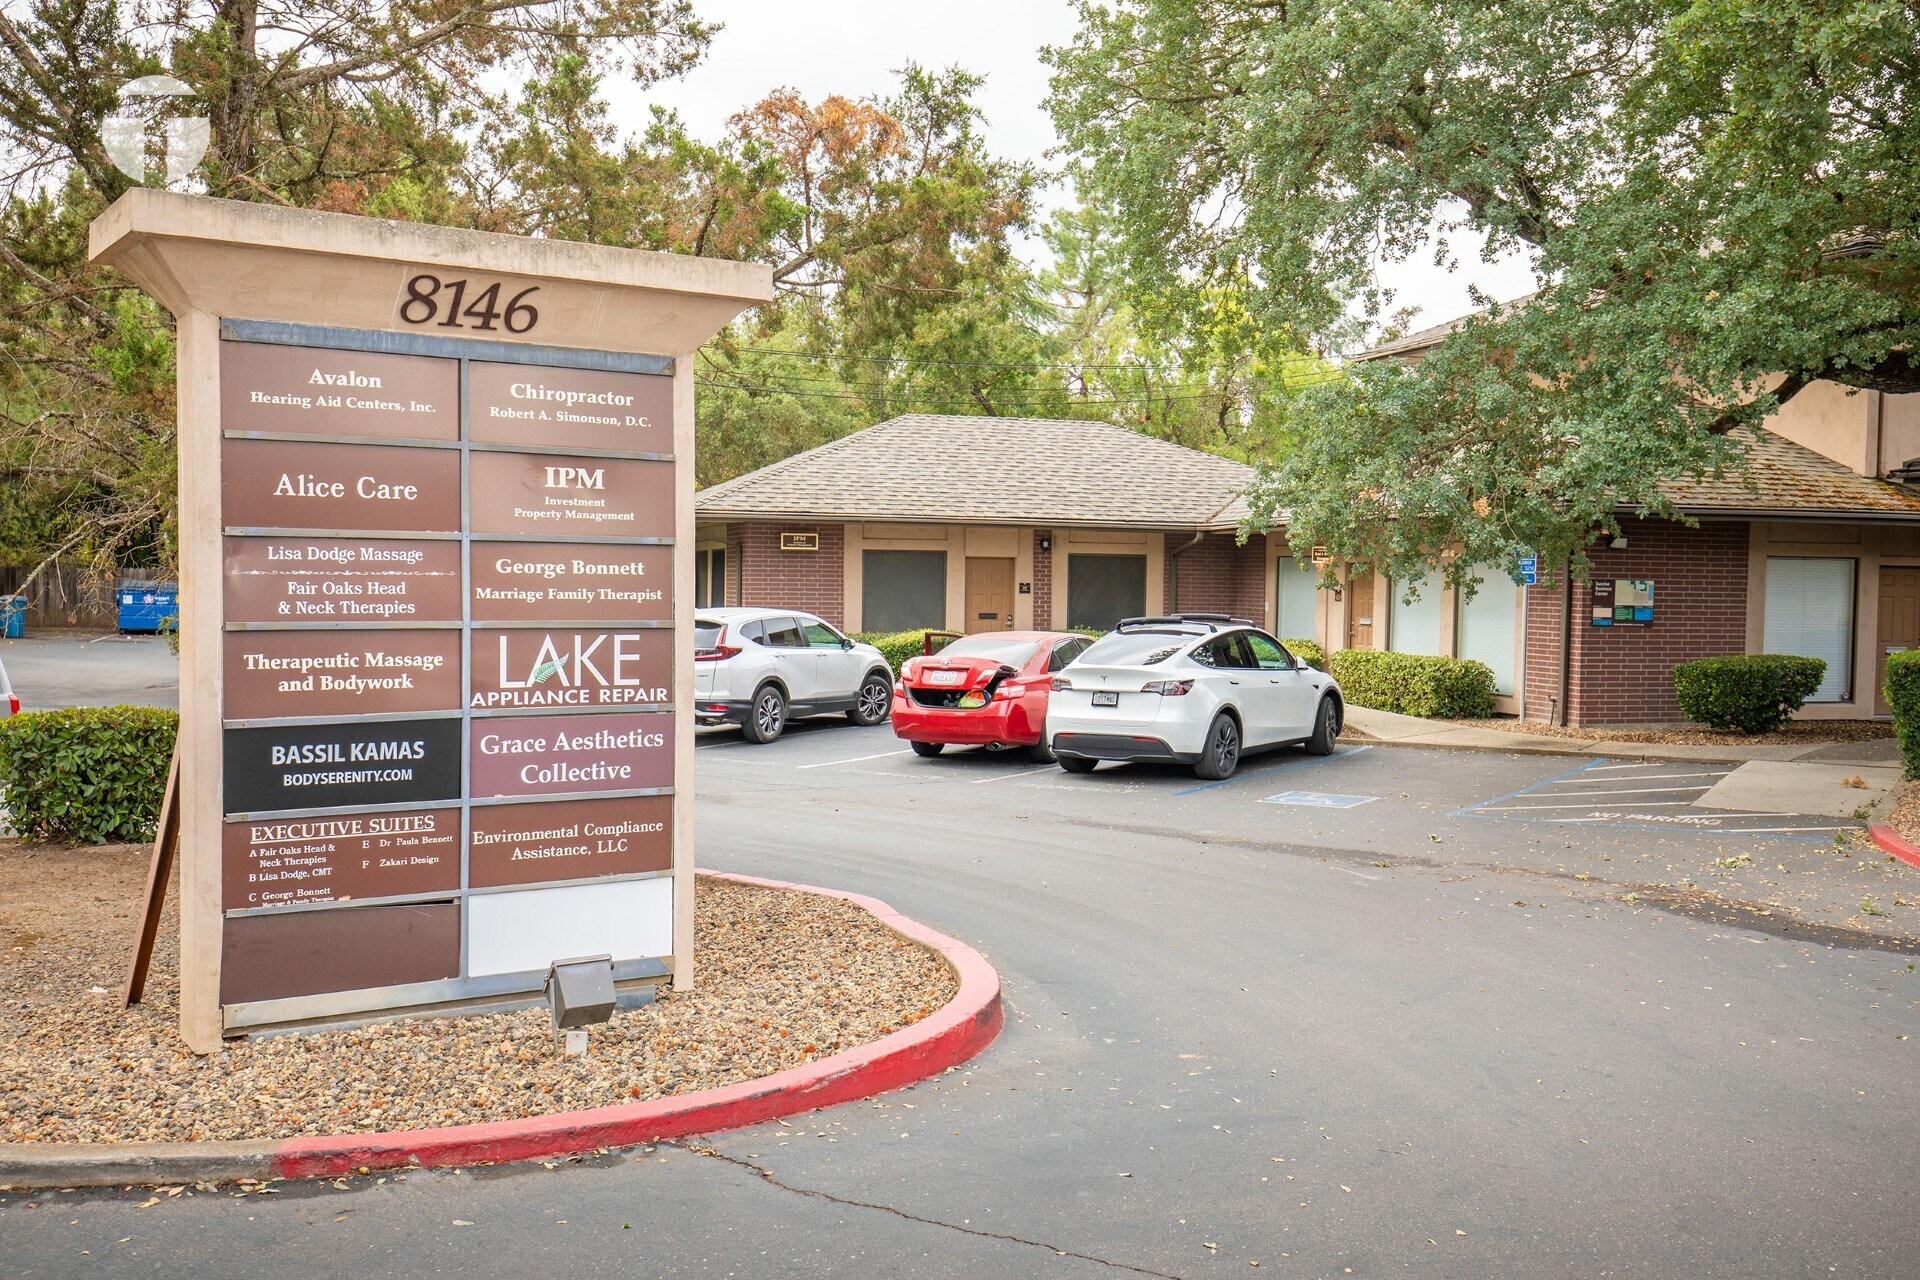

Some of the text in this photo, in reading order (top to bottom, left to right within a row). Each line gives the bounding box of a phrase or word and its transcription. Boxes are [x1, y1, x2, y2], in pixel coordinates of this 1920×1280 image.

[400, 274, 540, 333] 8146
[308, 369, 382, 388] Avalon
[250, 391, 436, 413] Hearing Aid Centers, Inc.
[510, 383, 634, 407] Chiropractor
[490, 406, 652, 428] Robert A. Simonson, D.C.
[273, 473, 418, 500] Alice Care
[544, 466, 605, 490] IPM
[545, 496, 605, 507] Investment
[514, 508, 635, 522] Property Management
[267, 547, 424, 564] Lisa Dodge Massage
[495, 559, 645, 578] George Bonnett
[287, 581, 406, 595] Fair Oaks Head
[475, 587, 663, 603] Marriage Family Therapist
[278, 601, 415, 617] & Neck Therapies
[243, 652, 443, 673] Therapeutic Massage
[500, 633, 640, 688] LAKE
[278, 674, 413, 694] and Bodywork
[471, 688, 668, 706] APPLIANCE REPAIR
[480, 730, 664, 754] Grace Aesthetics
[271, 741, 425, 765] BASSIL KAMAS
[283, 769, 412, 787] BODYSERENITY.COM
[520, 761, 631, 784] Collective
[250, 815, 435, 842] EXECUTIVE SUITES
[1625, 813, 1723, 826] PARKING
[362, 834, 453, 849] E Dr Paula Bennett
[473, 821, 664, 845] Environmental Compliance
[249, 844, 336, 858] A Fair Oaks Head &
[511, 839, 628, 861] Assistance, LLC
[259, 856, 327, 868] Neck Therapies
[362, 856, 439, 869] F Zakari Design
[249, 868, 333, 882] B Lisa Dodge, CMT
[249, 887, 331, 902] C George Bonnett
